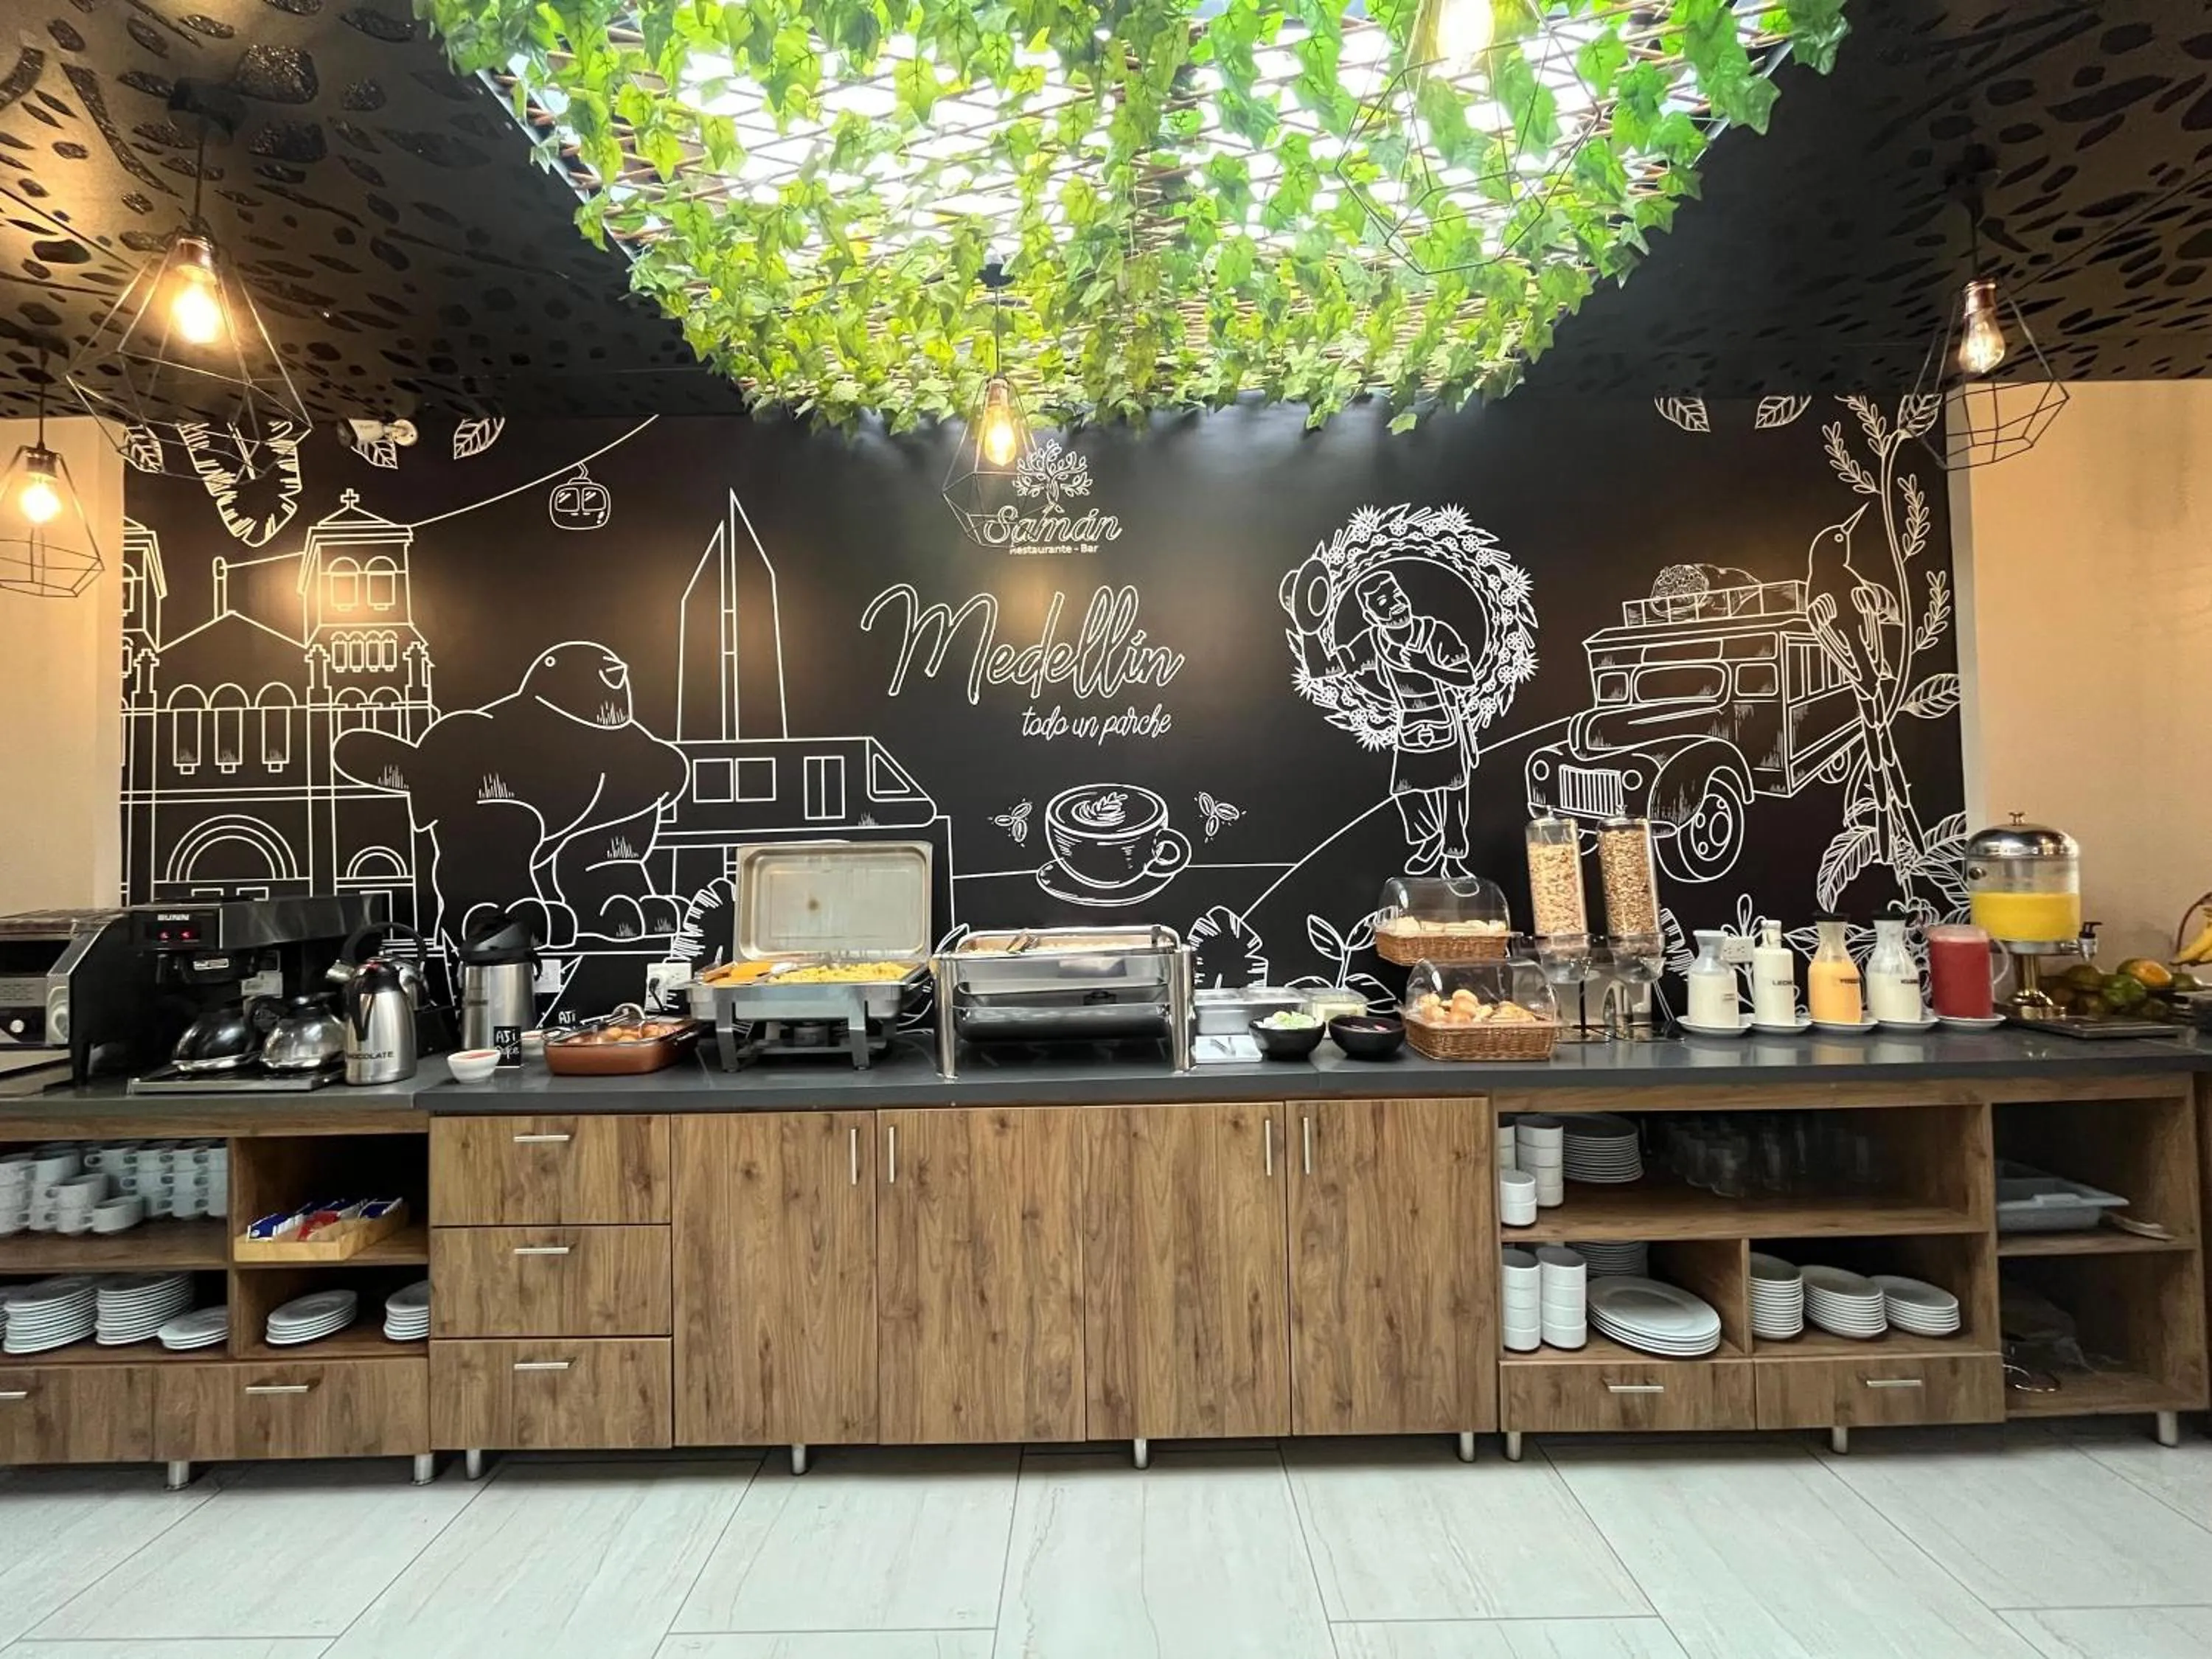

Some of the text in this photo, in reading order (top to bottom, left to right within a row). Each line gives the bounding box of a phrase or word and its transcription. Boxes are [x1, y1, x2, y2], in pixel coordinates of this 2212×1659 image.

[1009, 545, 1072, 554] Restaurante
[1080, 543, 1099, 553] Bar
[860, 583, 1186, 706] Medellín
[1021, 703, 1172, 745] todo un parche
